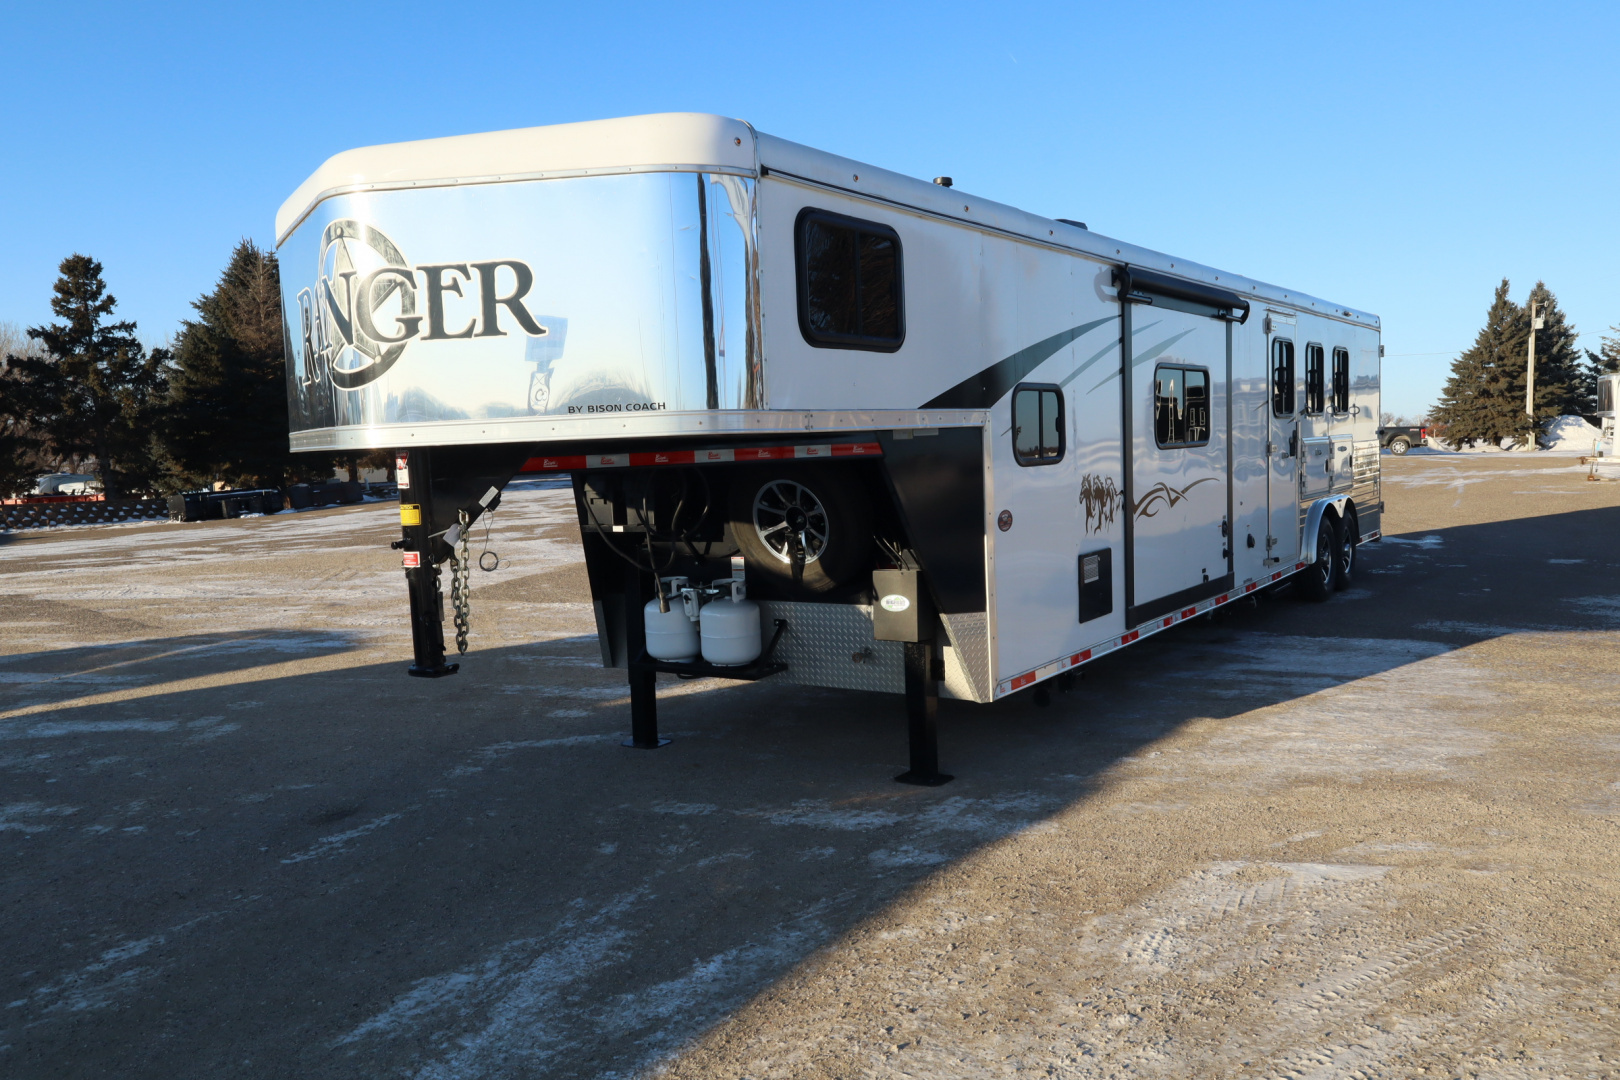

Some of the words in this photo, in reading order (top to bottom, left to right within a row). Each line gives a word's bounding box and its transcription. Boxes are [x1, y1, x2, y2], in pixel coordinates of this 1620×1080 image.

[568, 405, 583, 414] BY
[587, 404, 622, 413] BISON
[625, 402, 666, 412] COACH
